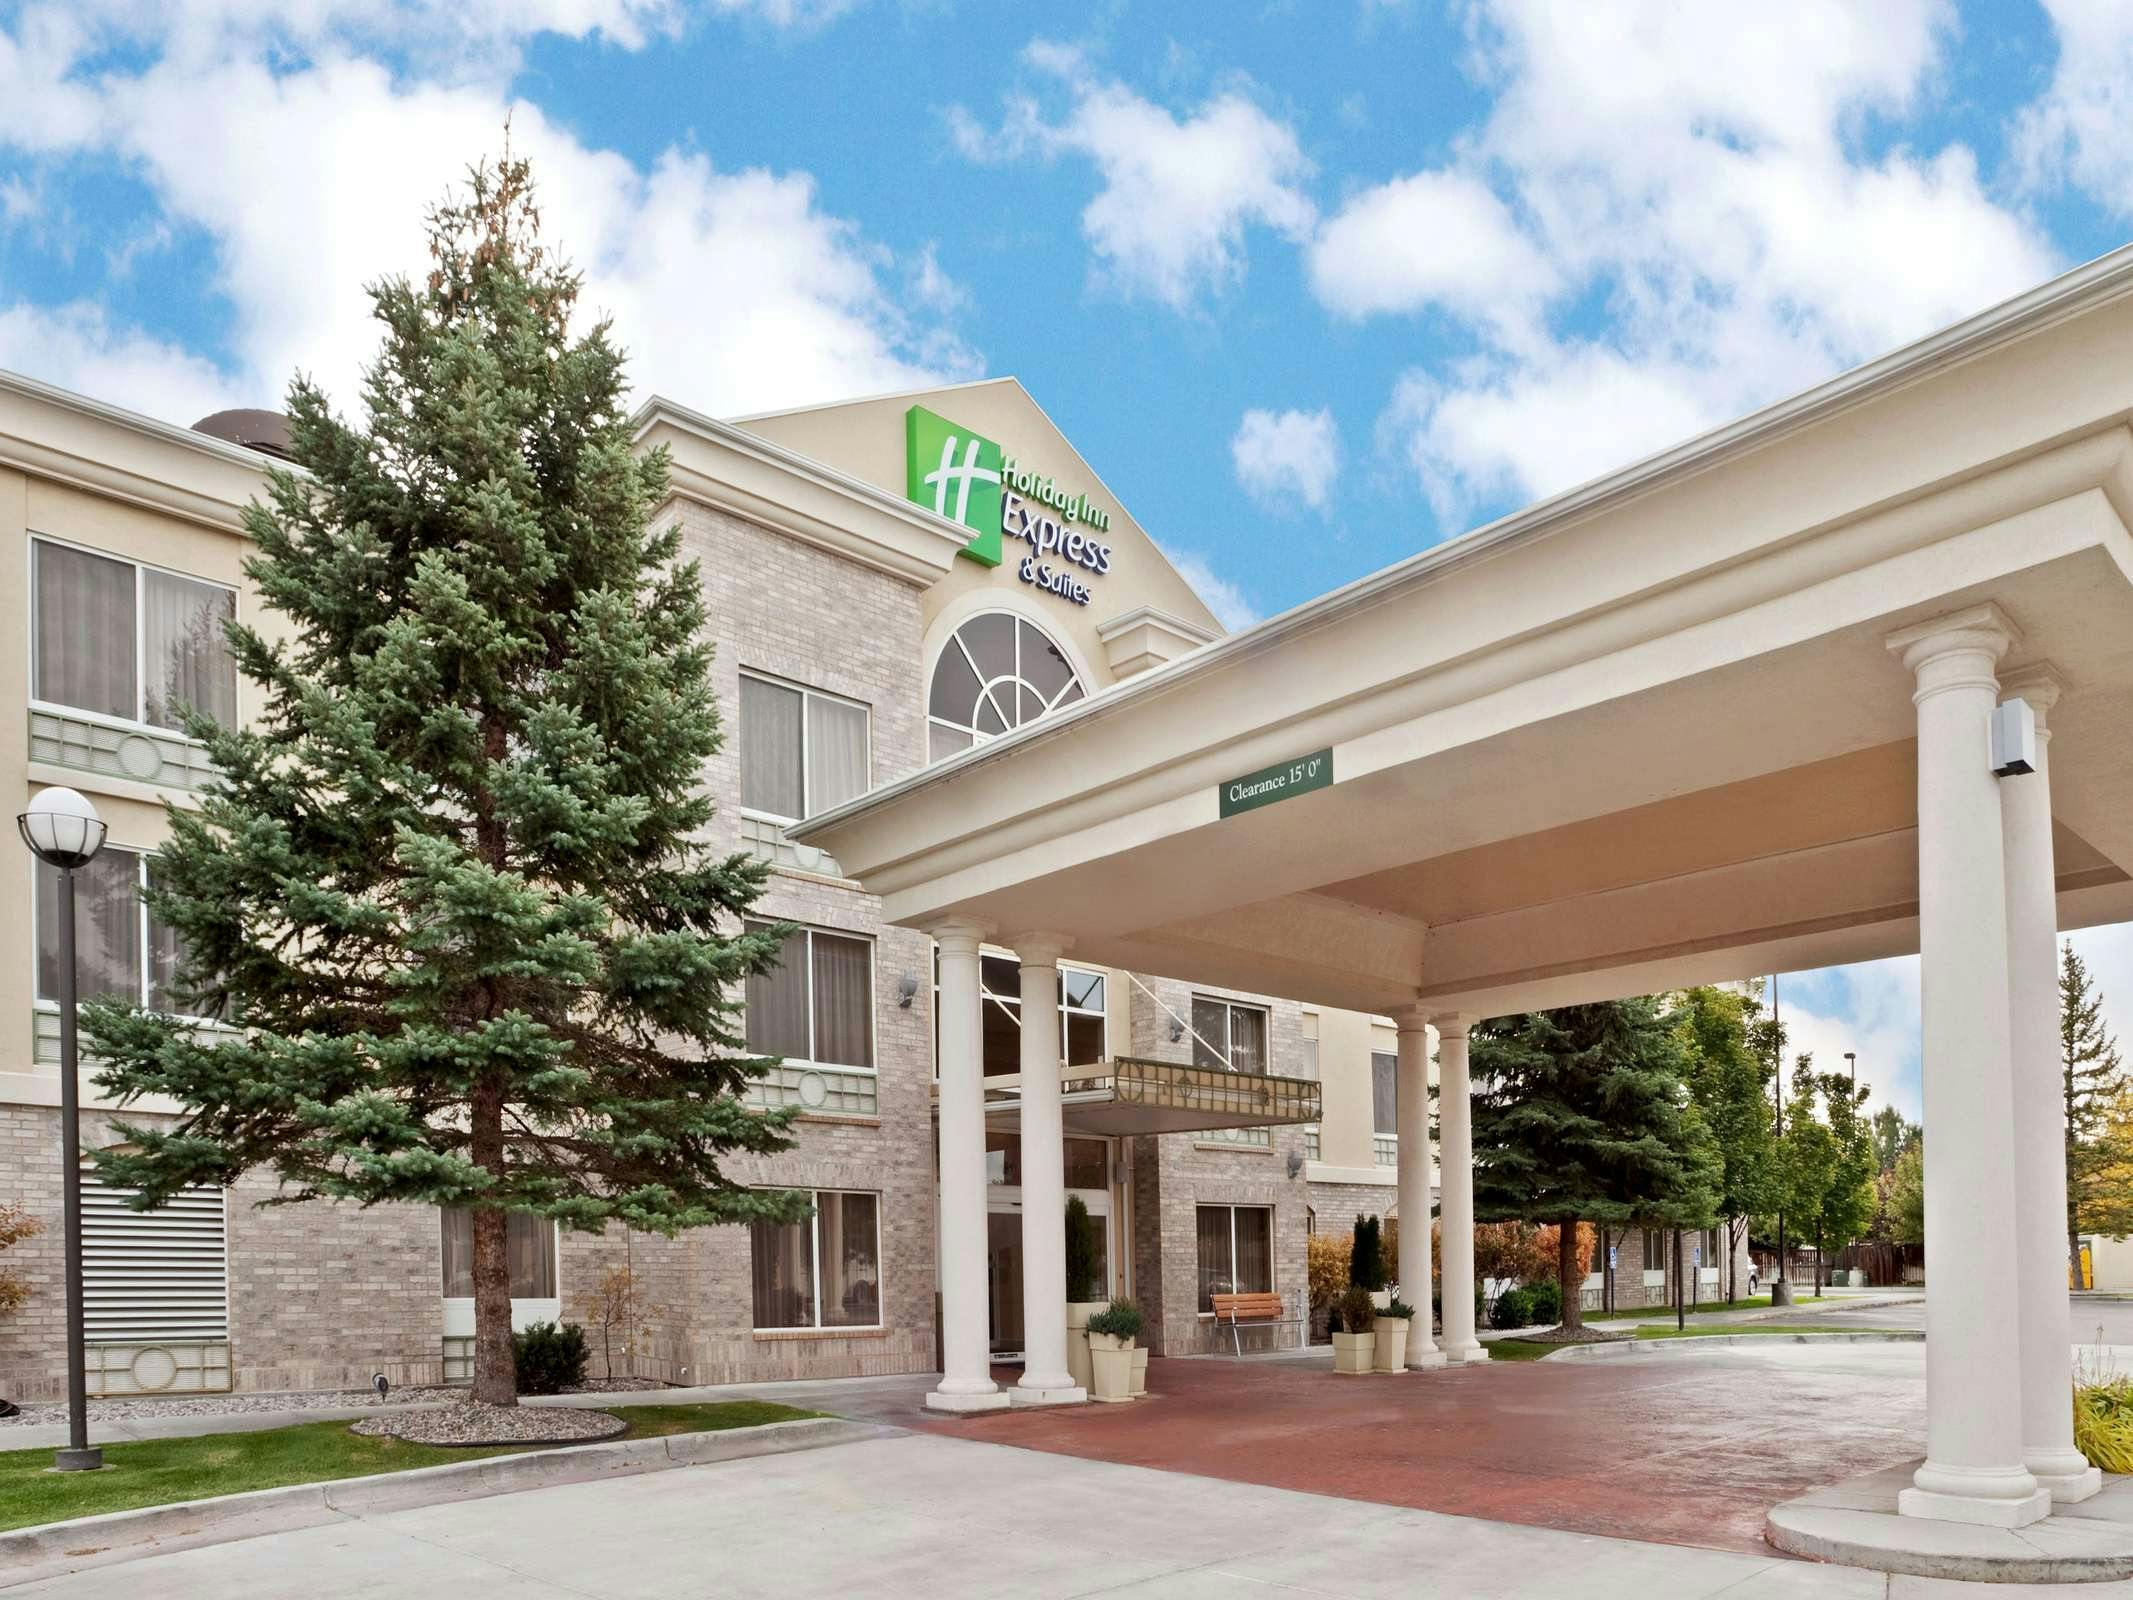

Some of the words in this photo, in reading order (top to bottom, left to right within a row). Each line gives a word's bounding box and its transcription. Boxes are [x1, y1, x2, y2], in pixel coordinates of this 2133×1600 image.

[1001, 455, 1079, 521] Holiday
[1081, 494, 1111, 531] Inn
[1002, 491, 1112, 575] Express
[1020, 557, 1036, 582] &
[1039, 564, 1092, 605] Suites
[1229, 774, 1286, 802] Clearance
[1289, 763, 1305, 784] 15'
